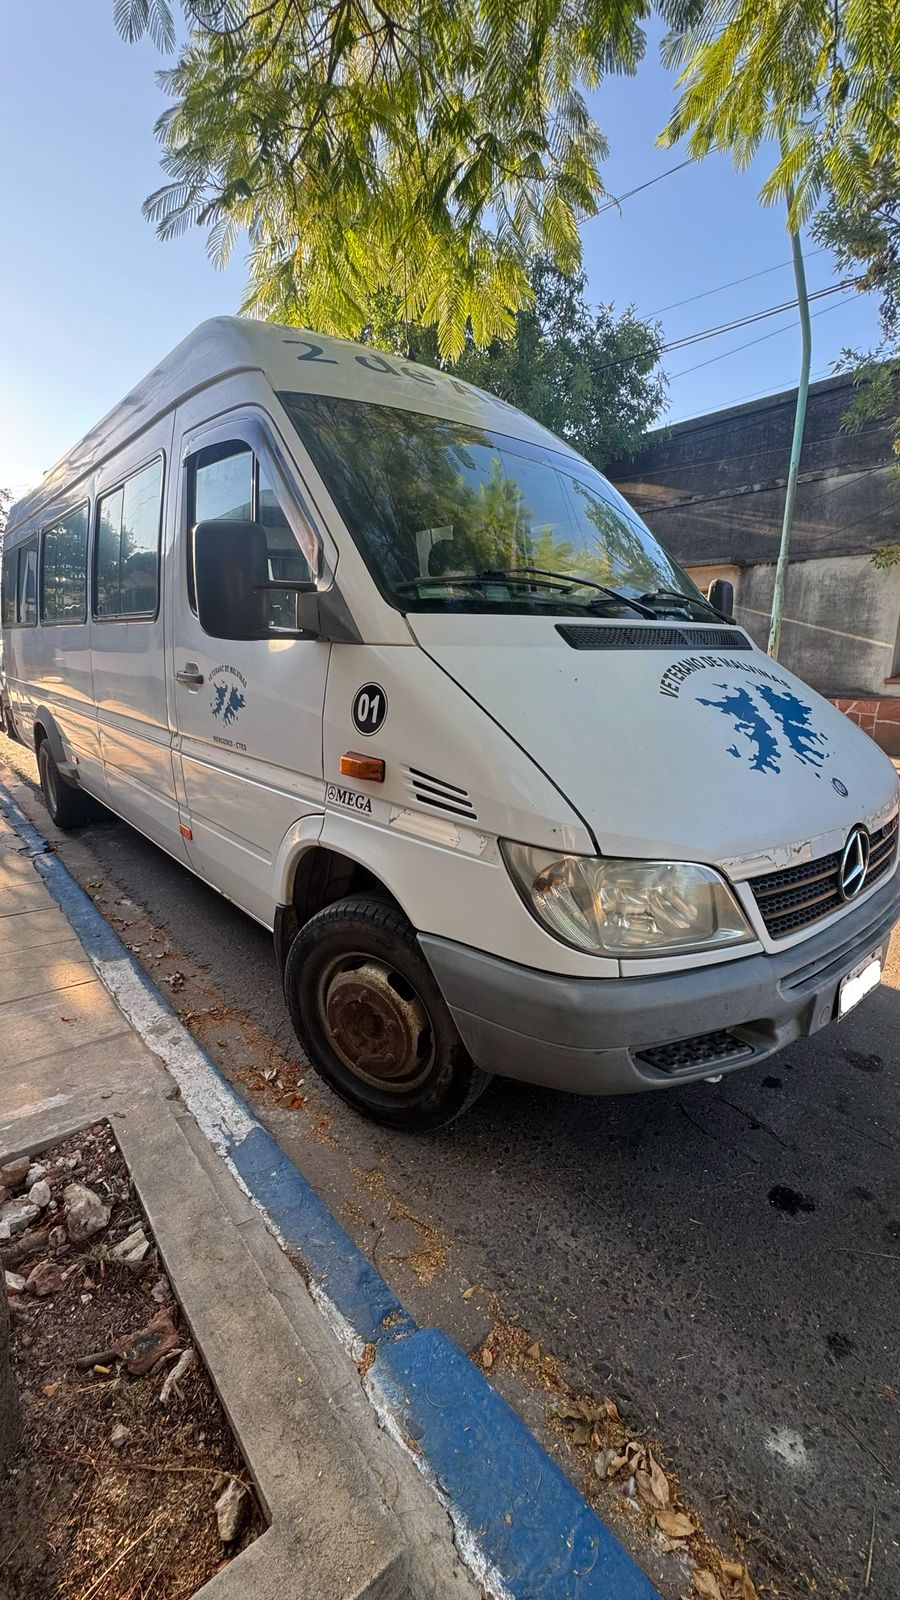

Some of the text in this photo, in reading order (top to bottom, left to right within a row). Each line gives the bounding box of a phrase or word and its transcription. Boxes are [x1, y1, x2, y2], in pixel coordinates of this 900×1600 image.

[282, 340, 437, 386] 2 de
[660, 656, 791, 698] VETERANO DE MALVINAS
[357, 693, 381, 724] 01
